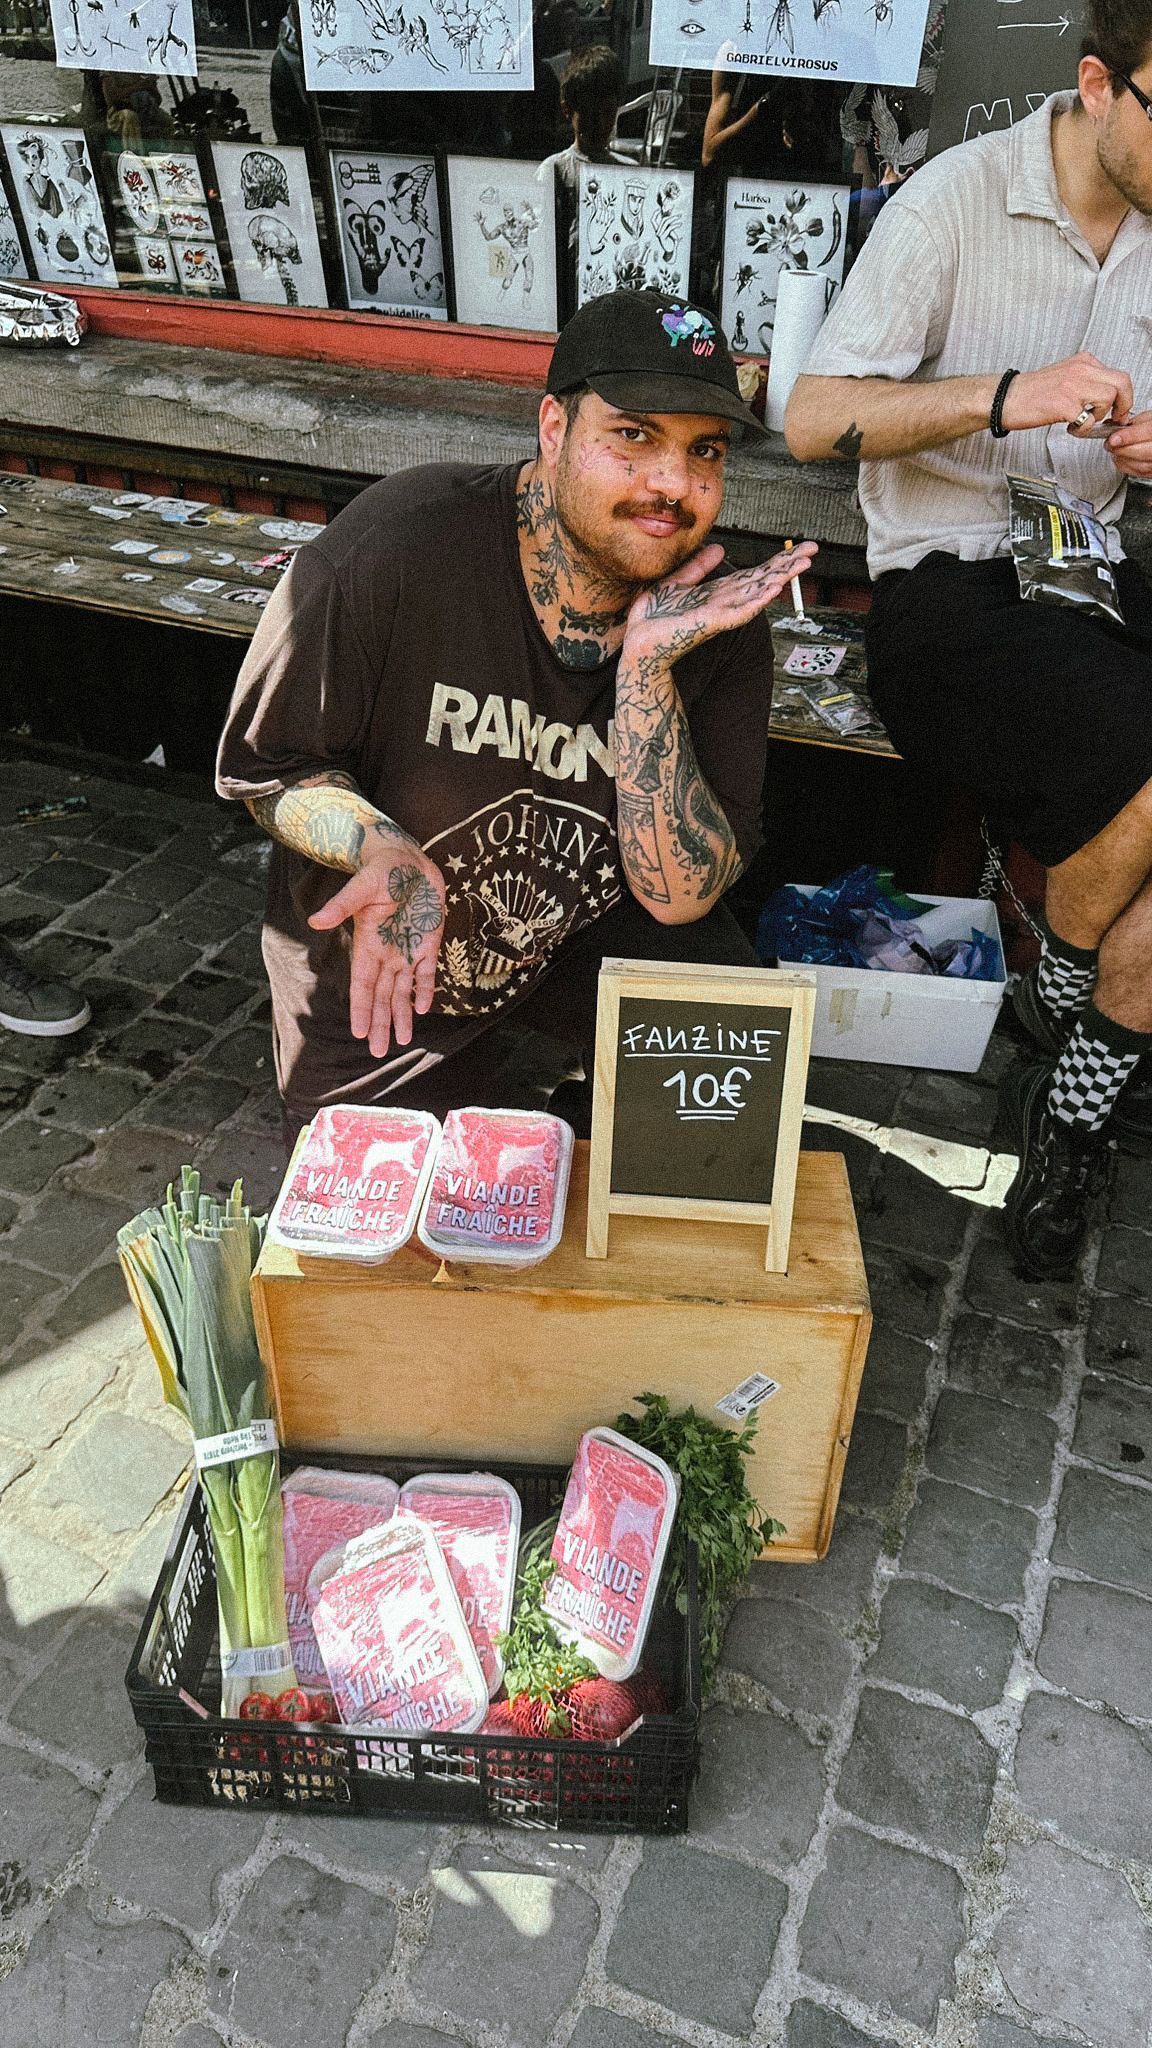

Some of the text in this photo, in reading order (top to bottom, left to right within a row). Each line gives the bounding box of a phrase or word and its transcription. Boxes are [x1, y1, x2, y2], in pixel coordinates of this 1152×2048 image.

[726, 52, 839, 71] GABRIELVIROSUS
[483, 893, 508, 917] HEY HO
[663, 1066, 752, 1109] 10€
[306, 1170, 404, 1202] VIANDE
[447, 1173, 541, 1207] VIANDE
[289, 1197, 395, 1232] FRAÎCHE
[438, 1204, 539, 1237] FRAÎCHE
[561, 1532, 643, 1603] VIANDE
[549, 1575, 632, 1648] FRAÎCHE
